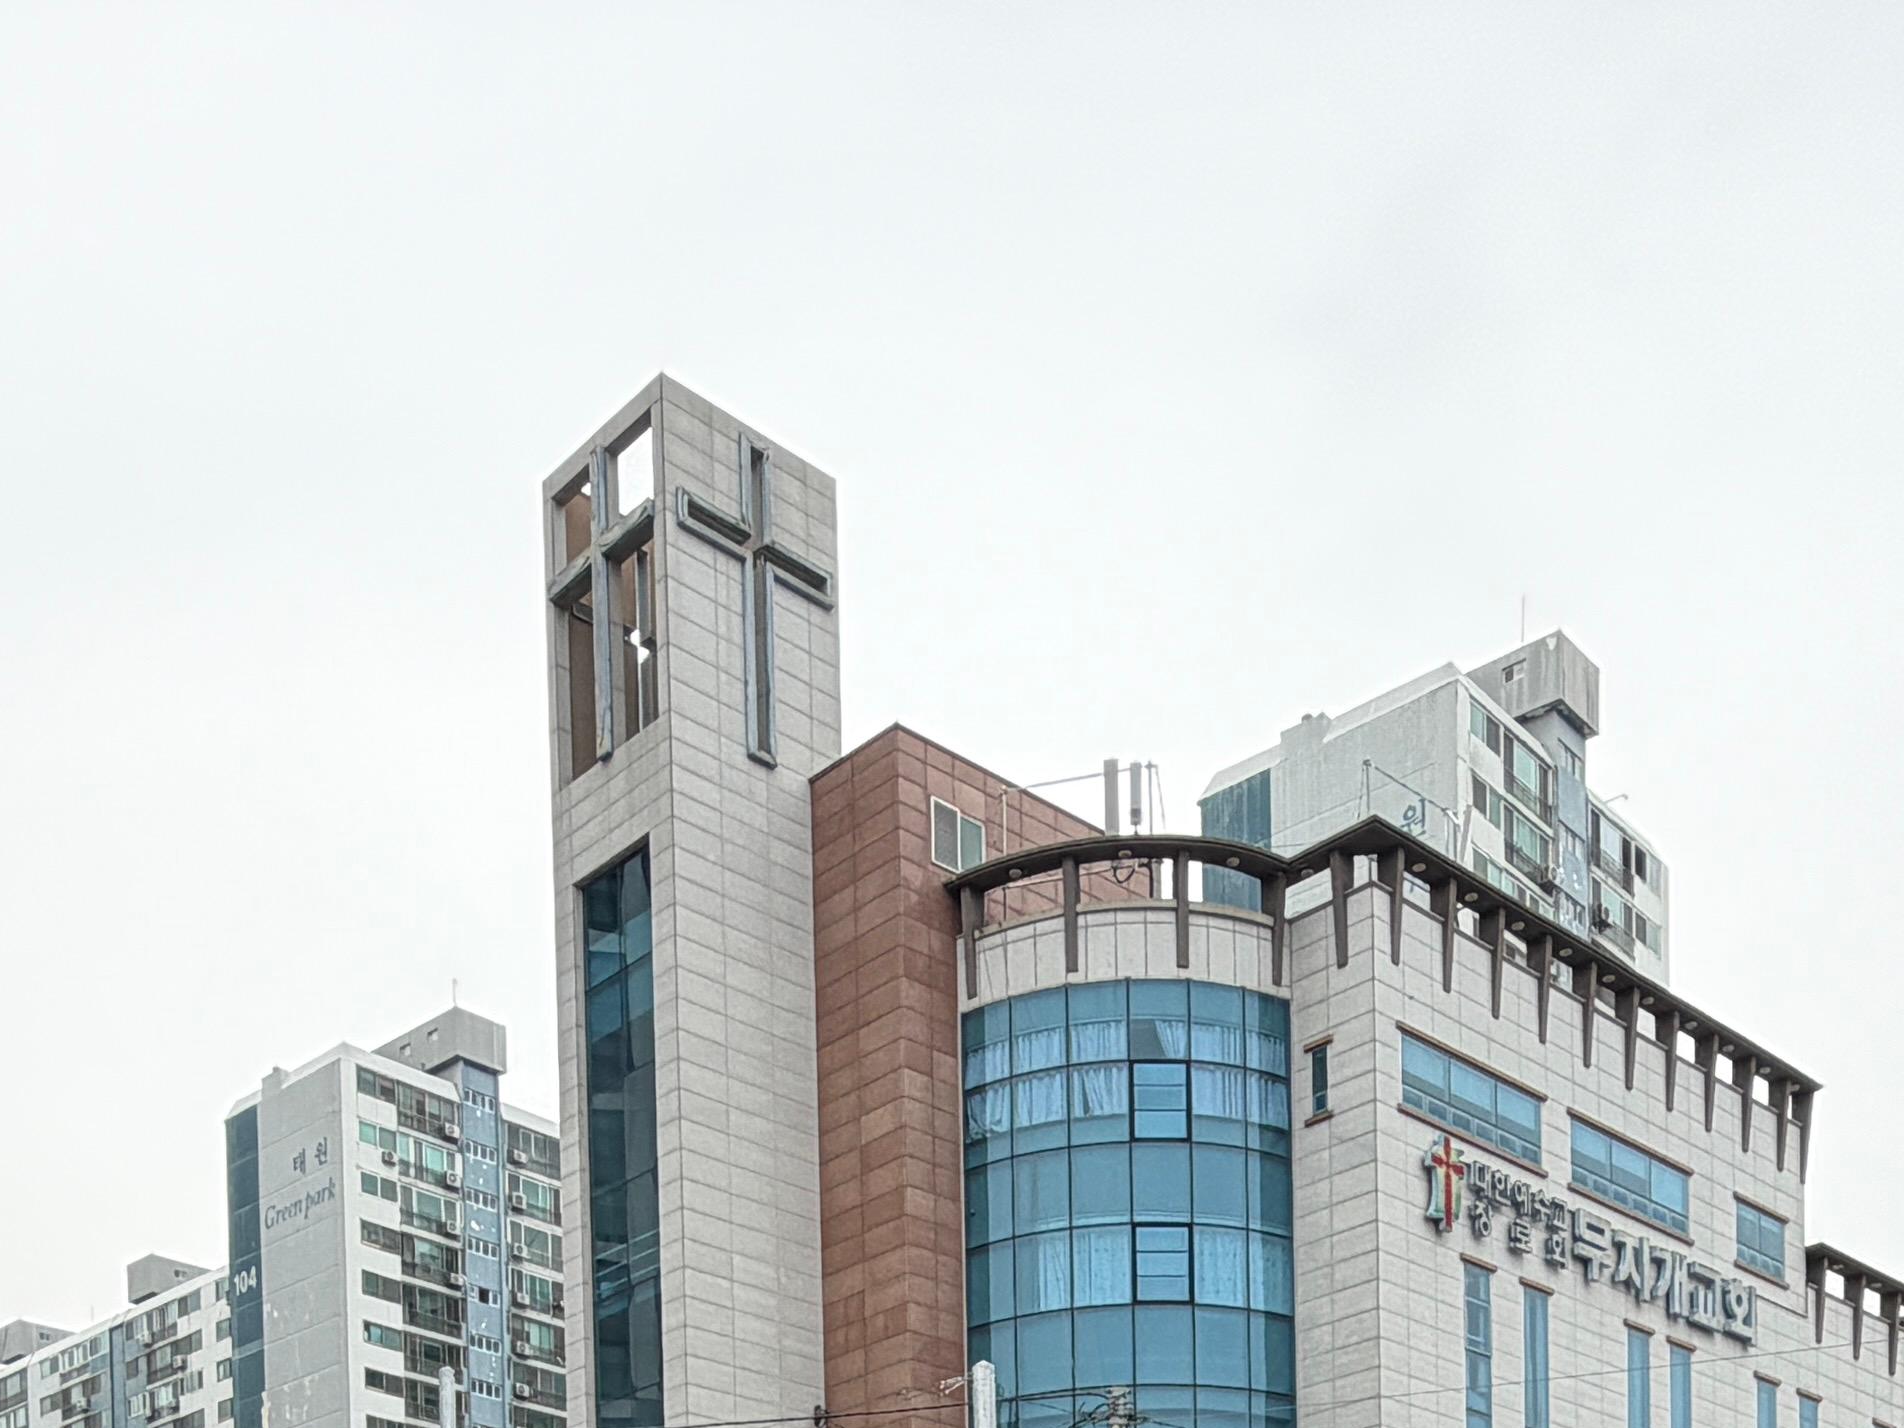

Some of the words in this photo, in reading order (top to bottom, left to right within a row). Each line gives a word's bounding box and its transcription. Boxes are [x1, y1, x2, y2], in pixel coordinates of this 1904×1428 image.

[1468, 1160, 1569, 1231] 대한예수교
[234, 1265, 258, 1297] 104
[1572, 1204, 1757, 1346] 무지개교회
